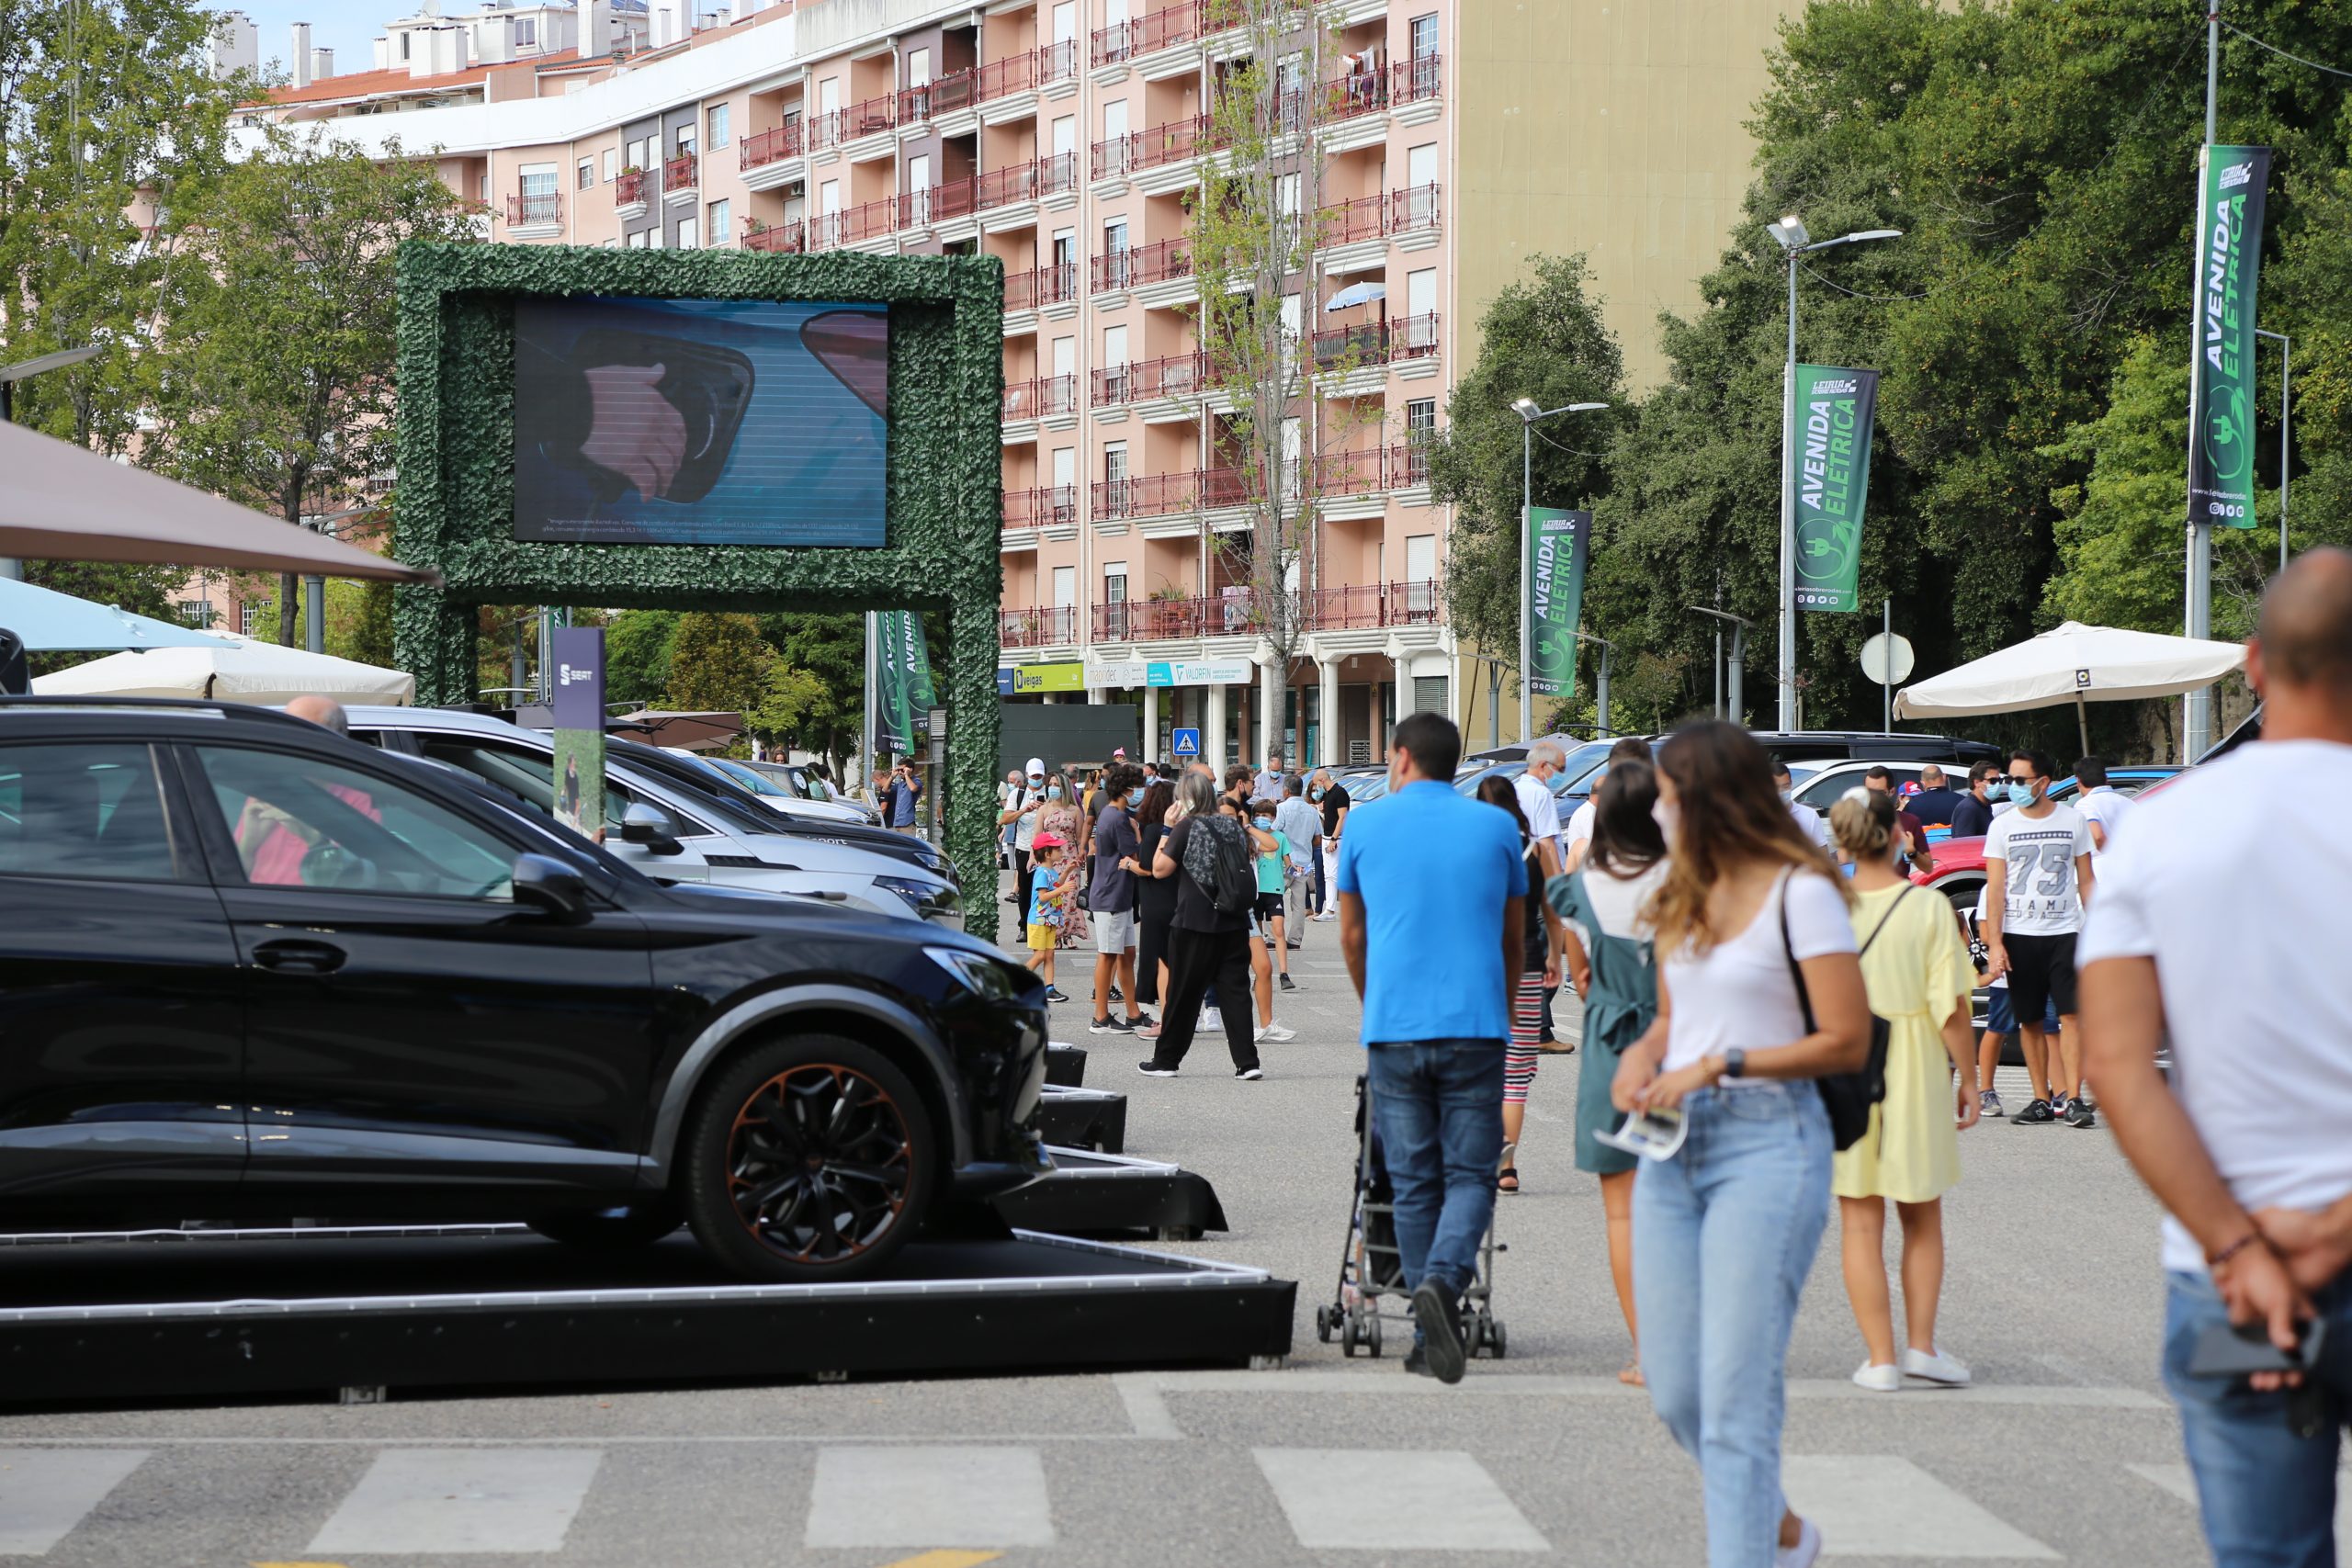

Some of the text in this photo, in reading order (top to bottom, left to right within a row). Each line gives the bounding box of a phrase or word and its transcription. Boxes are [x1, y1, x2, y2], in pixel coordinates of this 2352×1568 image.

[2207, 199, 2230, 372] AVENIDA
[2223, 194, 2247, 379] ELÉTRICA
[1813, 379, 1845, 389] LEIRIA
[1802, 401, 1831, 510] AVENIDA
[1825, 399, 1856, 516] ELÉTRICA
[1534, 536, 1555, 620] AVENIDA
[1550, 534, 1575, 625] ELÉTRICA
[570, 670, 593, 681] SEAT
[1023, 672, 1043, 689] veigas
[1185, 667, 1211, 680] VALORFIN
[2008, 843, 2072, 897] 75
